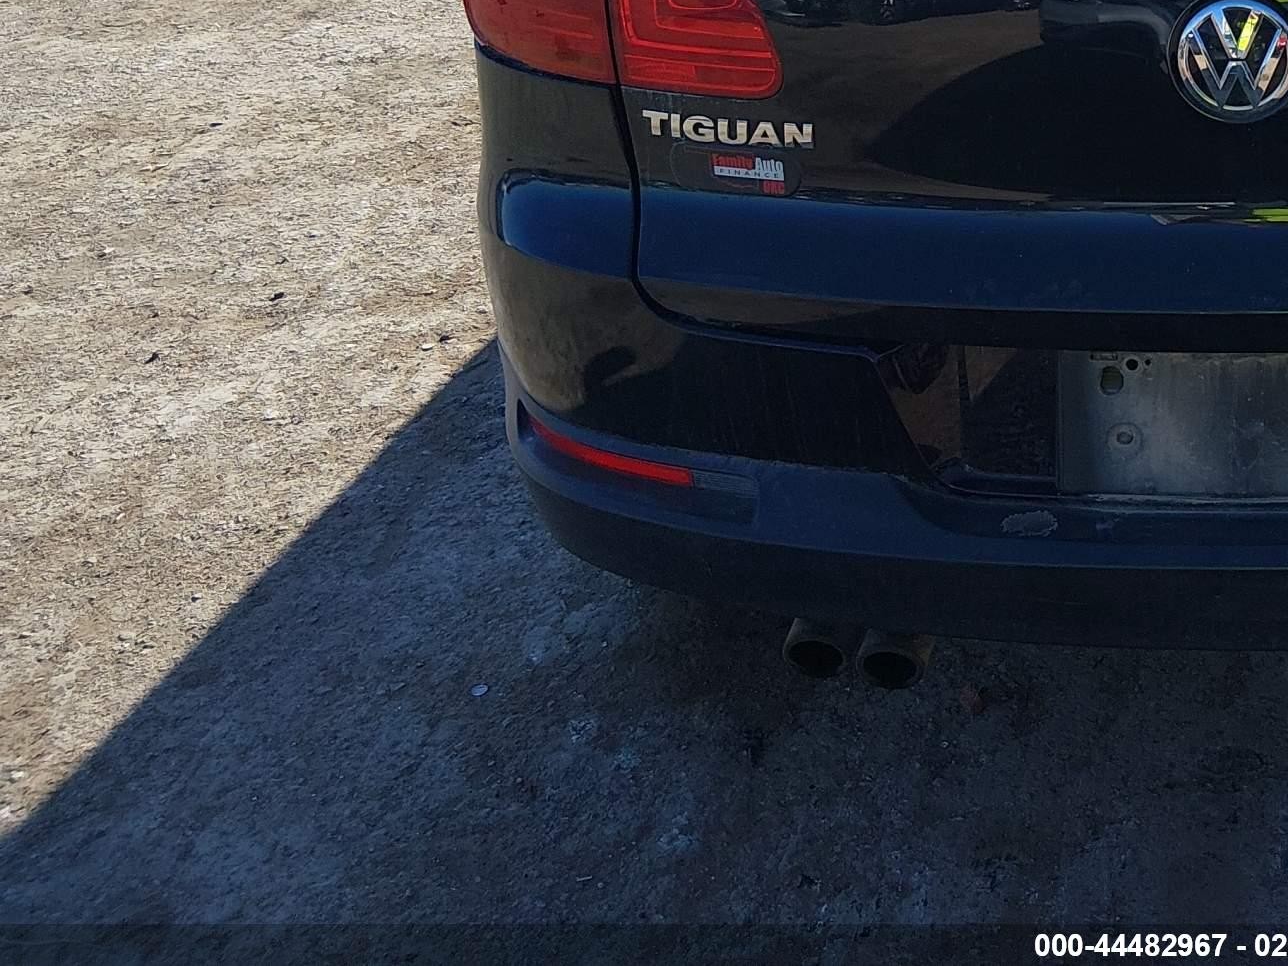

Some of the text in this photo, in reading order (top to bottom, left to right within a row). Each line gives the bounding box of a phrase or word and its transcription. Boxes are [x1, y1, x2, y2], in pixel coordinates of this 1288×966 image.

[642, 109, 814, 149] TIGUAN
[755, 157, 784, 173] Auto
[719, 168, 780, 179] FINANCE
